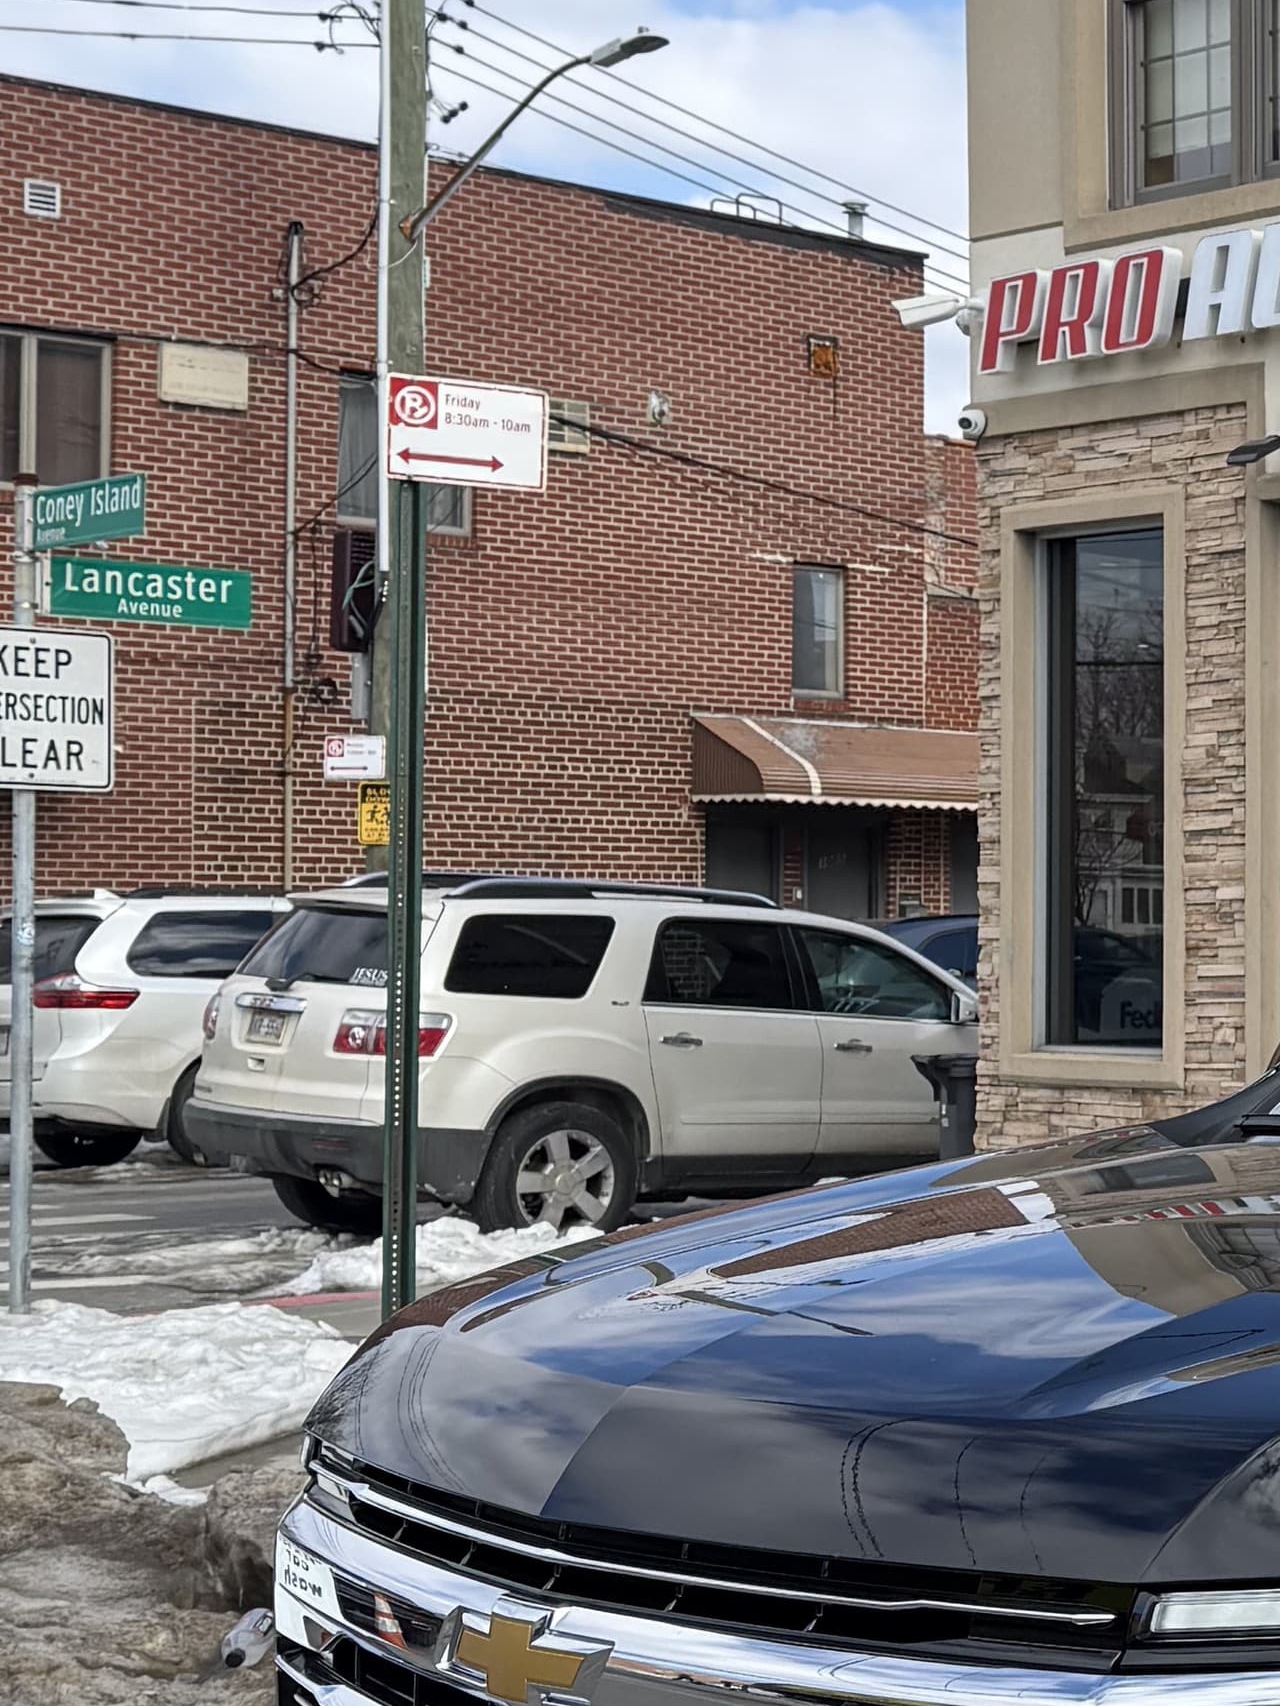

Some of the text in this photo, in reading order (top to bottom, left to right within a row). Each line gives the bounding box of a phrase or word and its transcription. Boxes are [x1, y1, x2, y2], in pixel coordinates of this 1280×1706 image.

[979, 245, 1185, 375] PRO
[444, 394, 481, 411] Friday
[444, 413, 490, 428] 8:30am
[501, 419, 532, 433] 10am
[36, 476, 141, 527] Coney Island
[36, 527, 66, 543] Avenue
[64, 562, 233, 604] Lancaster
[117, 598, 183, 618] Avenue
[0, 645, 72, 679] KEEP
[0, 692, 104, 725] RSECTION
[354, 967, 388, 983] JESUS
